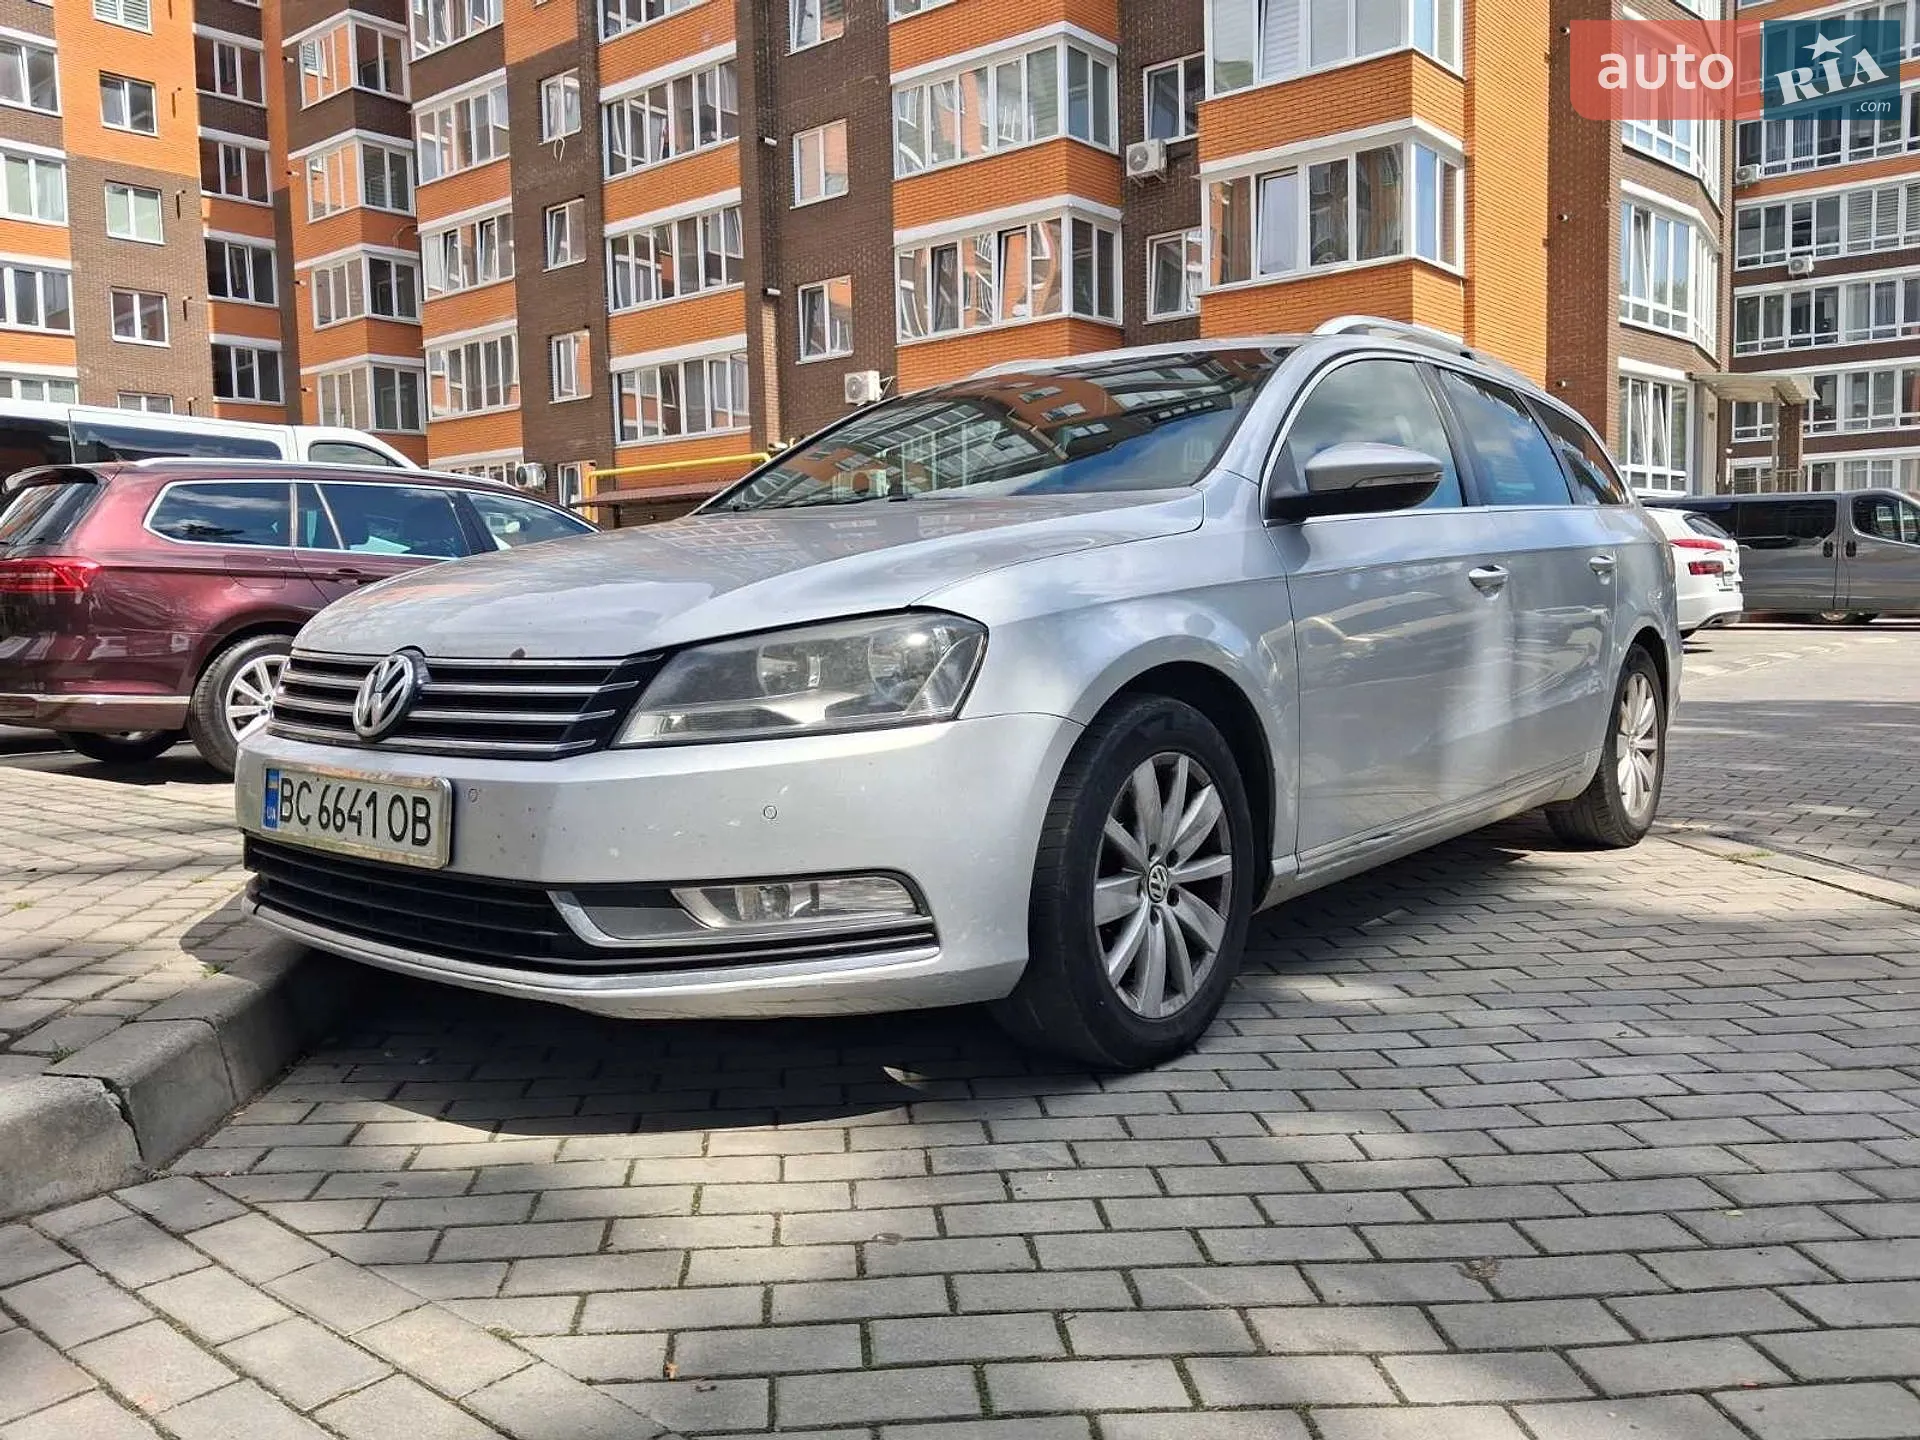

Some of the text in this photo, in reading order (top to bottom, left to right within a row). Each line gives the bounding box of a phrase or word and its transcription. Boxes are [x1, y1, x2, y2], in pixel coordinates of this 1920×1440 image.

[280, 777, 431, 846] BC 6641 OB
